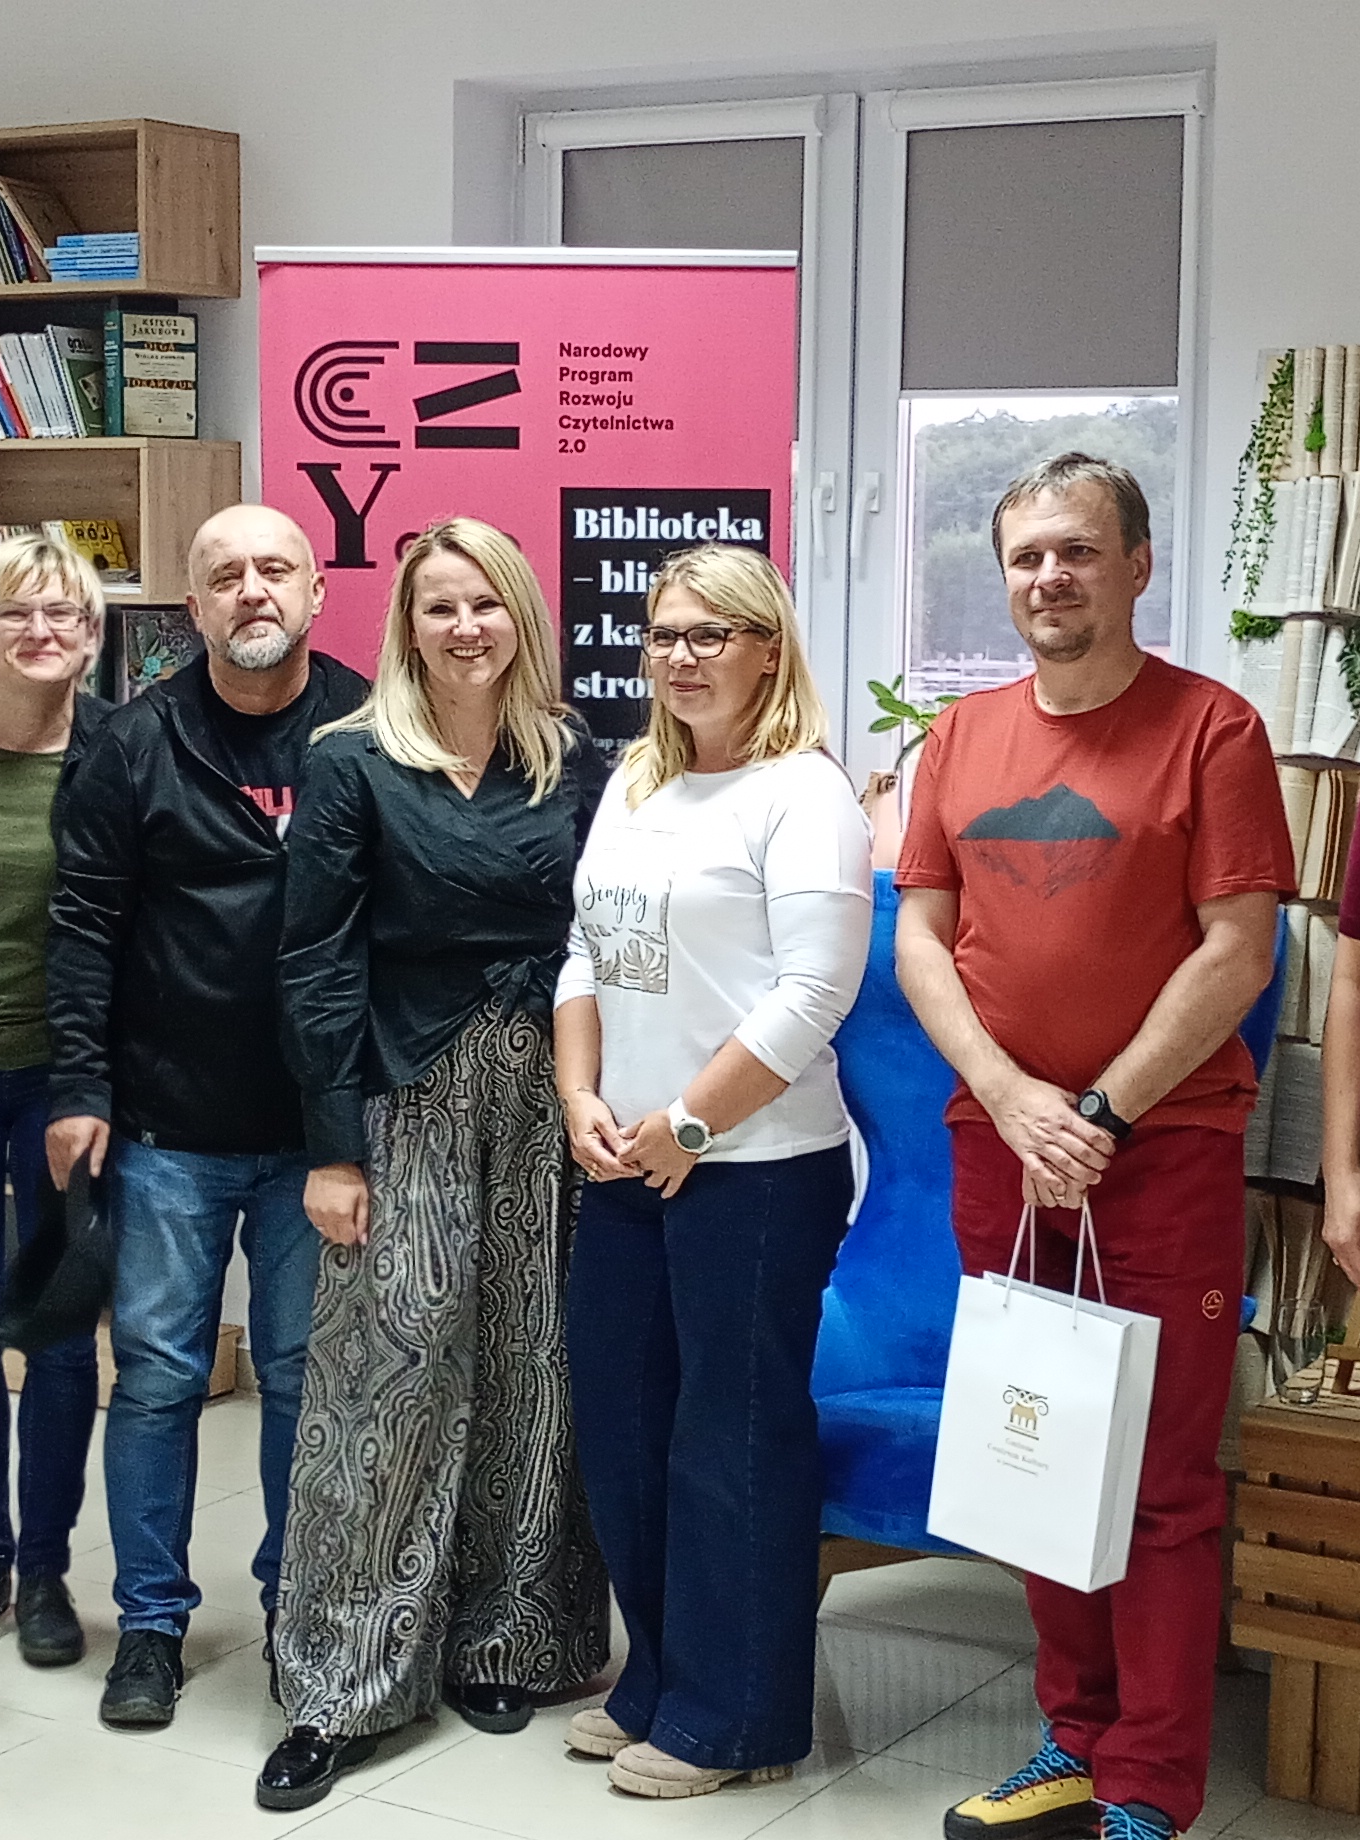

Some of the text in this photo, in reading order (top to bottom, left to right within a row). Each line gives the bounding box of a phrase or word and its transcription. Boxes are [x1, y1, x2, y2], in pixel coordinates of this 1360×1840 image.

[559, 342, 649, 361] Narodowy
[559, 366, 633, 385] Program
[559, 390, 633, 410] Rozwoju
[558, 415, 675, 433] Czytelnictwa
[558, 438, 587, 454] 2.0
[76, 523, 109, 540] RÓJ
[573, 507, 764, 541] Biblioteka
[574, 624, 594, 646] z
[582, 875, 648, 924] Simply
